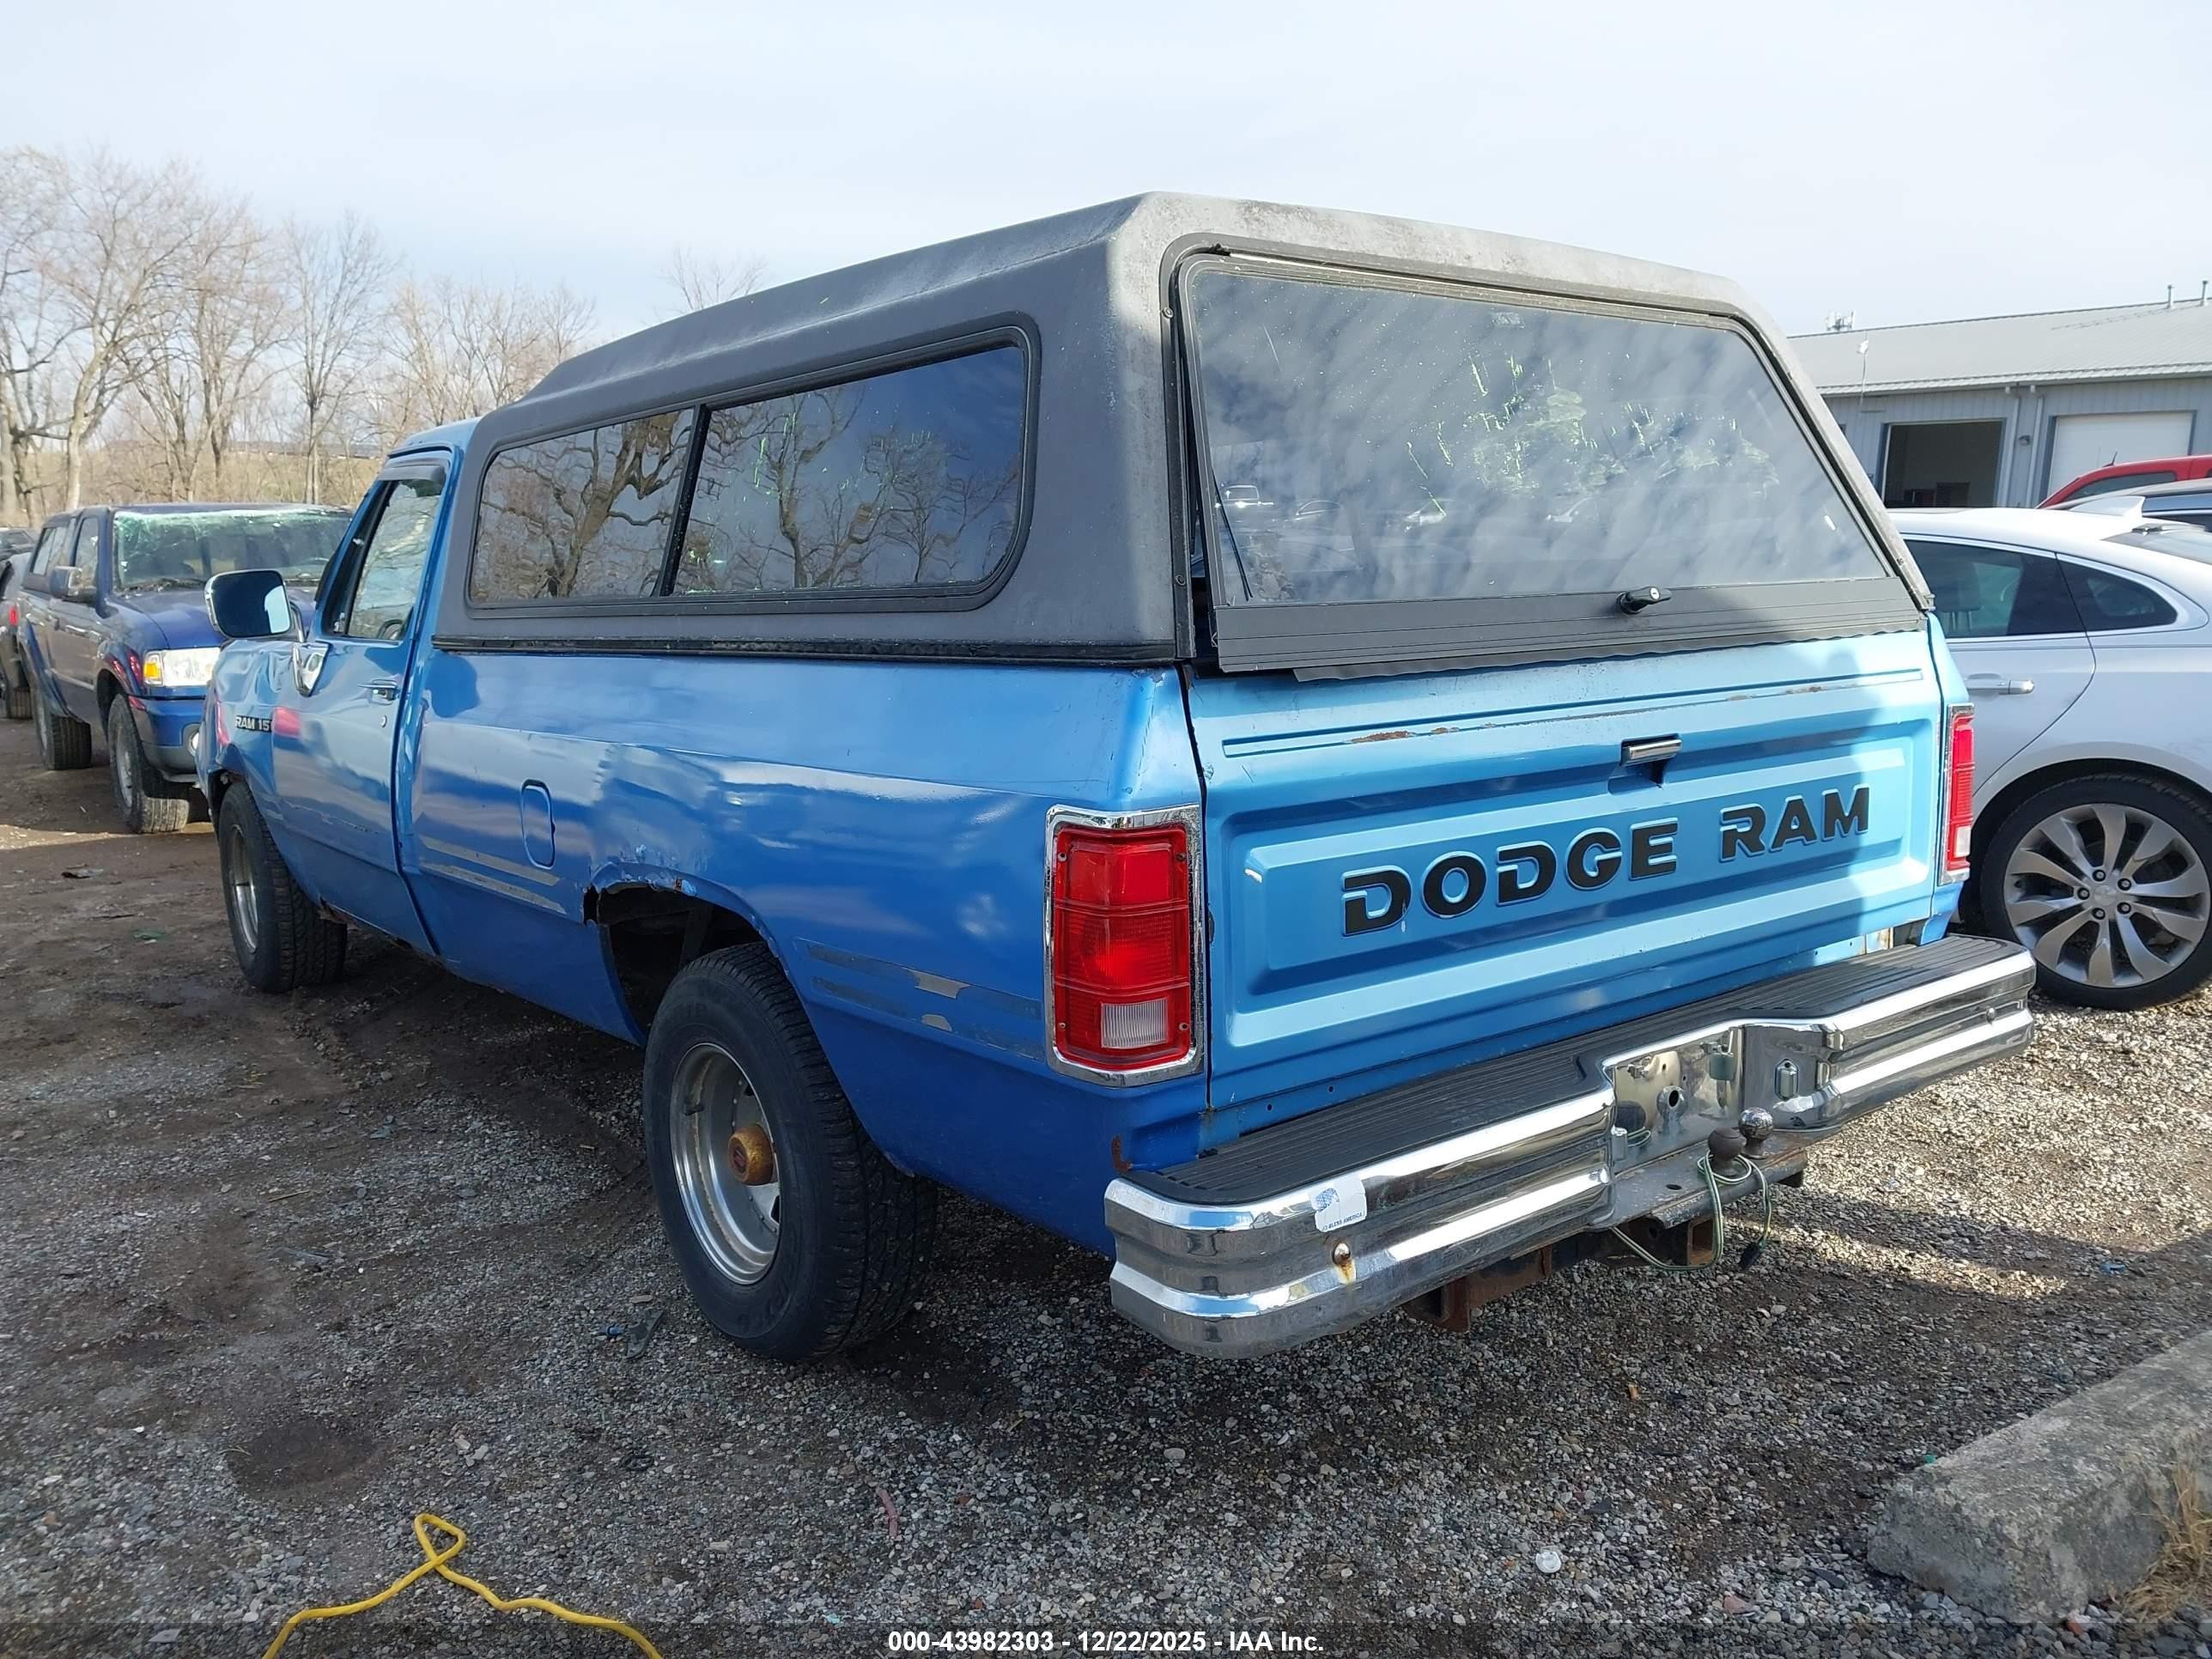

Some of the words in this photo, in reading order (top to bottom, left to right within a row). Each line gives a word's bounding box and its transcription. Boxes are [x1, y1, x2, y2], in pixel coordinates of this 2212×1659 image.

[234, 716, 255, 730] RAM
[258, 719, 271, 732] 15
[1342, 817, 1678, 937] DODGE
[1720, 785, 1869, 863] RAM
[1343, 1212, 1363, 1224] AMERICA
